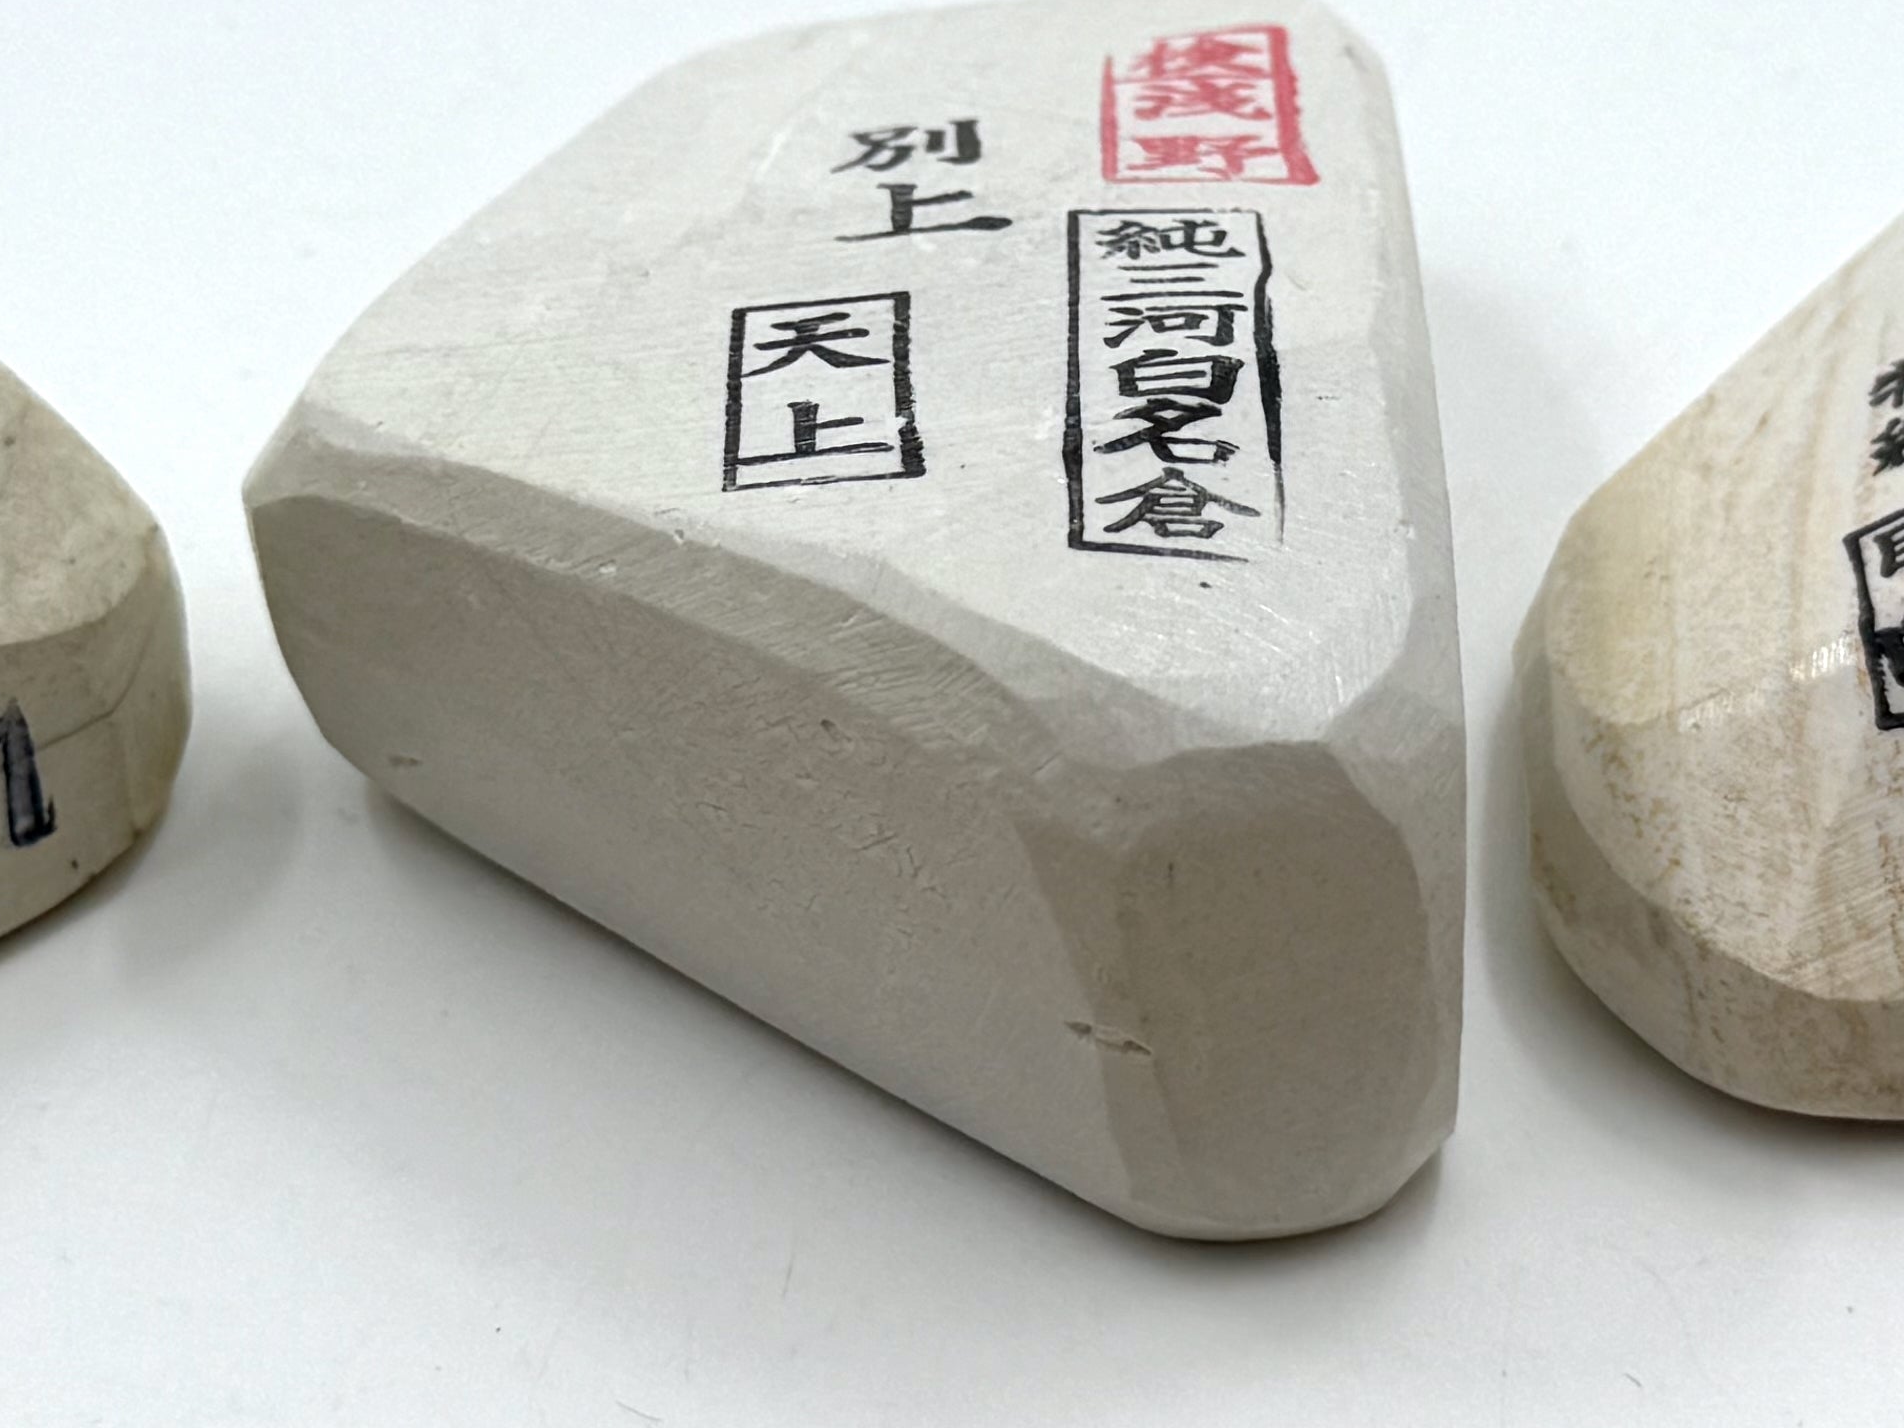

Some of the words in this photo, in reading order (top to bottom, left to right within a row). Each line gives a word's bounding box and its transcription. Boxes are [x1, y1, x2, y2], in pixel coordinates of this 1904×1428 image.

[831, 119, 1013, 241] 別上
[736, 312, 894, 467] 天上
[1094, 218, 1262, 540] 純三河白名倉
